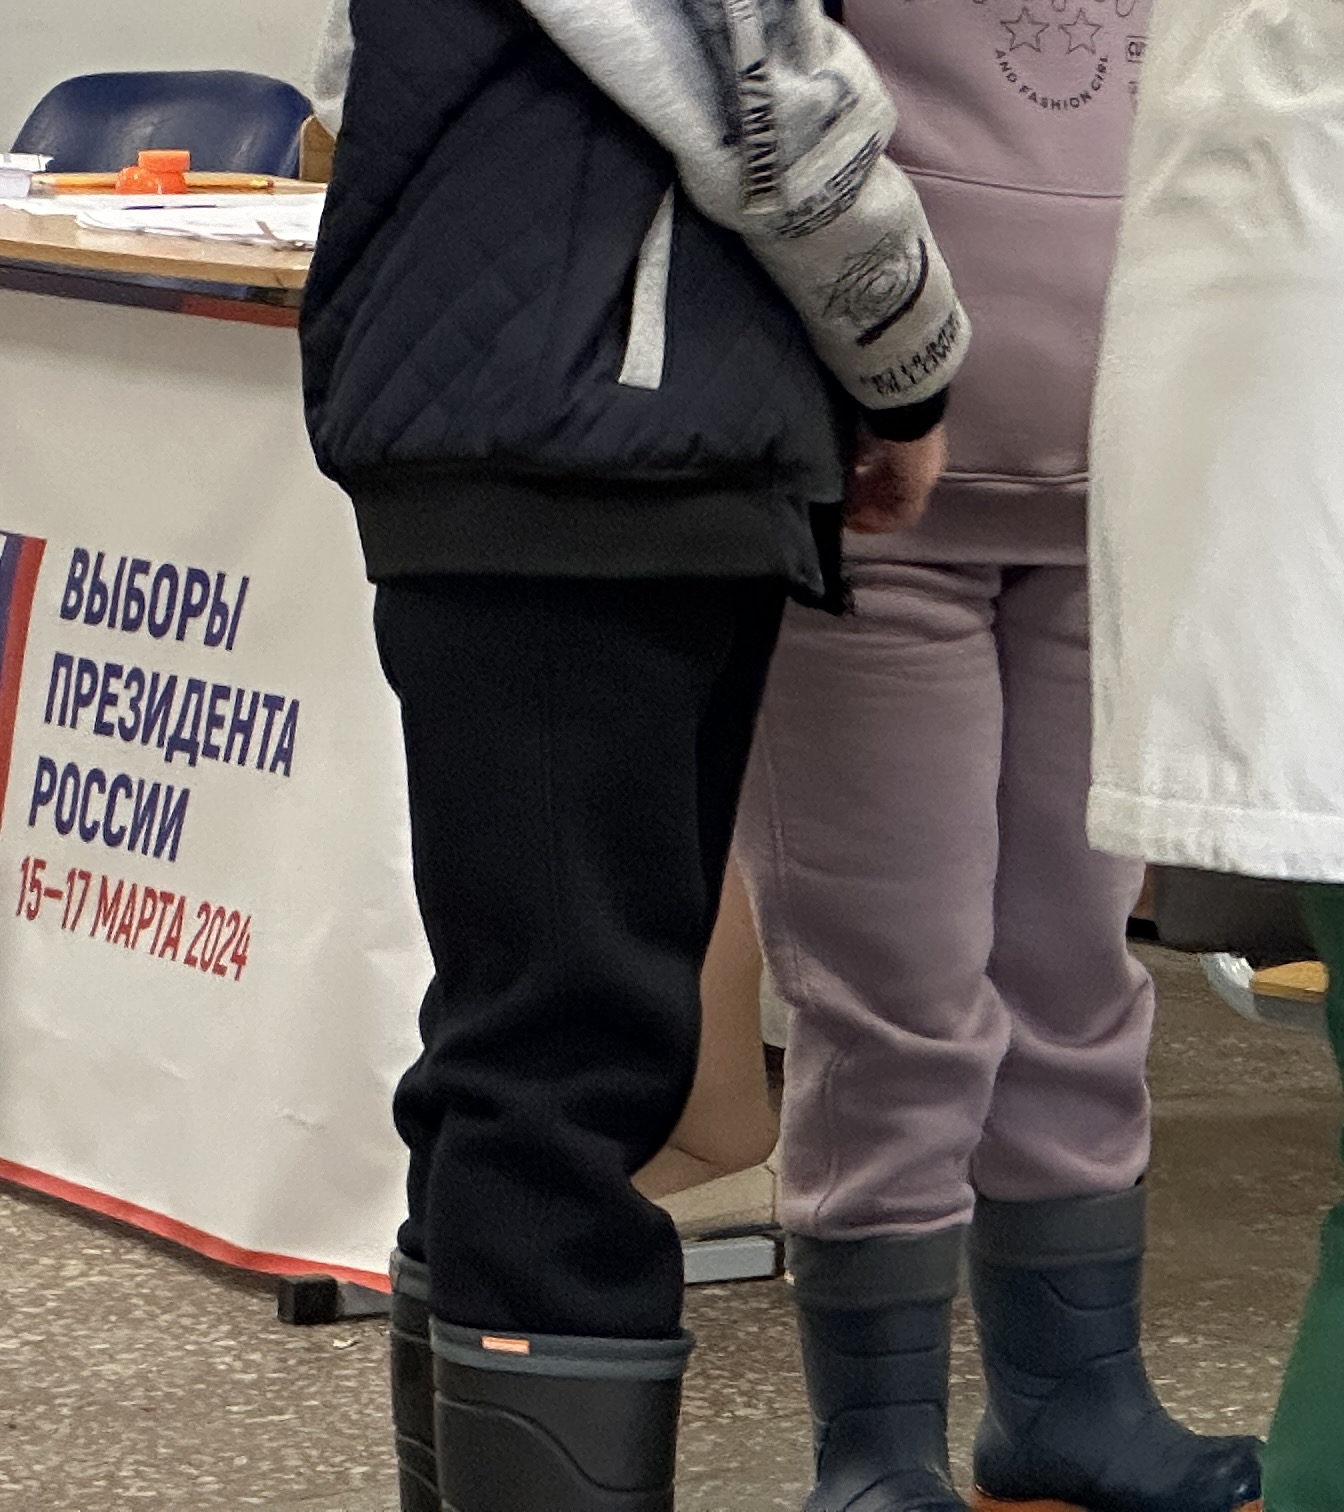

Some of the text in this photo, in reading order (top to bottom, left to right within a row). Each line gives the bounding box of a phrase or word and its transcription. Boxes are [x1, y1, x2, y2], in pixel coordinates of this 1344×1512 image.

[1019, 85, 1092, 110] FASHION
[60, 547, 250, 651] ВЫБОРЫ
[44, 651, 300, 778] ПРЕЗИДЕНТА
[28, 755, 191, 862] РОССИИ
[89, 873, 185, 964] МАРТА
[183, 901, 253, 982] 2024
